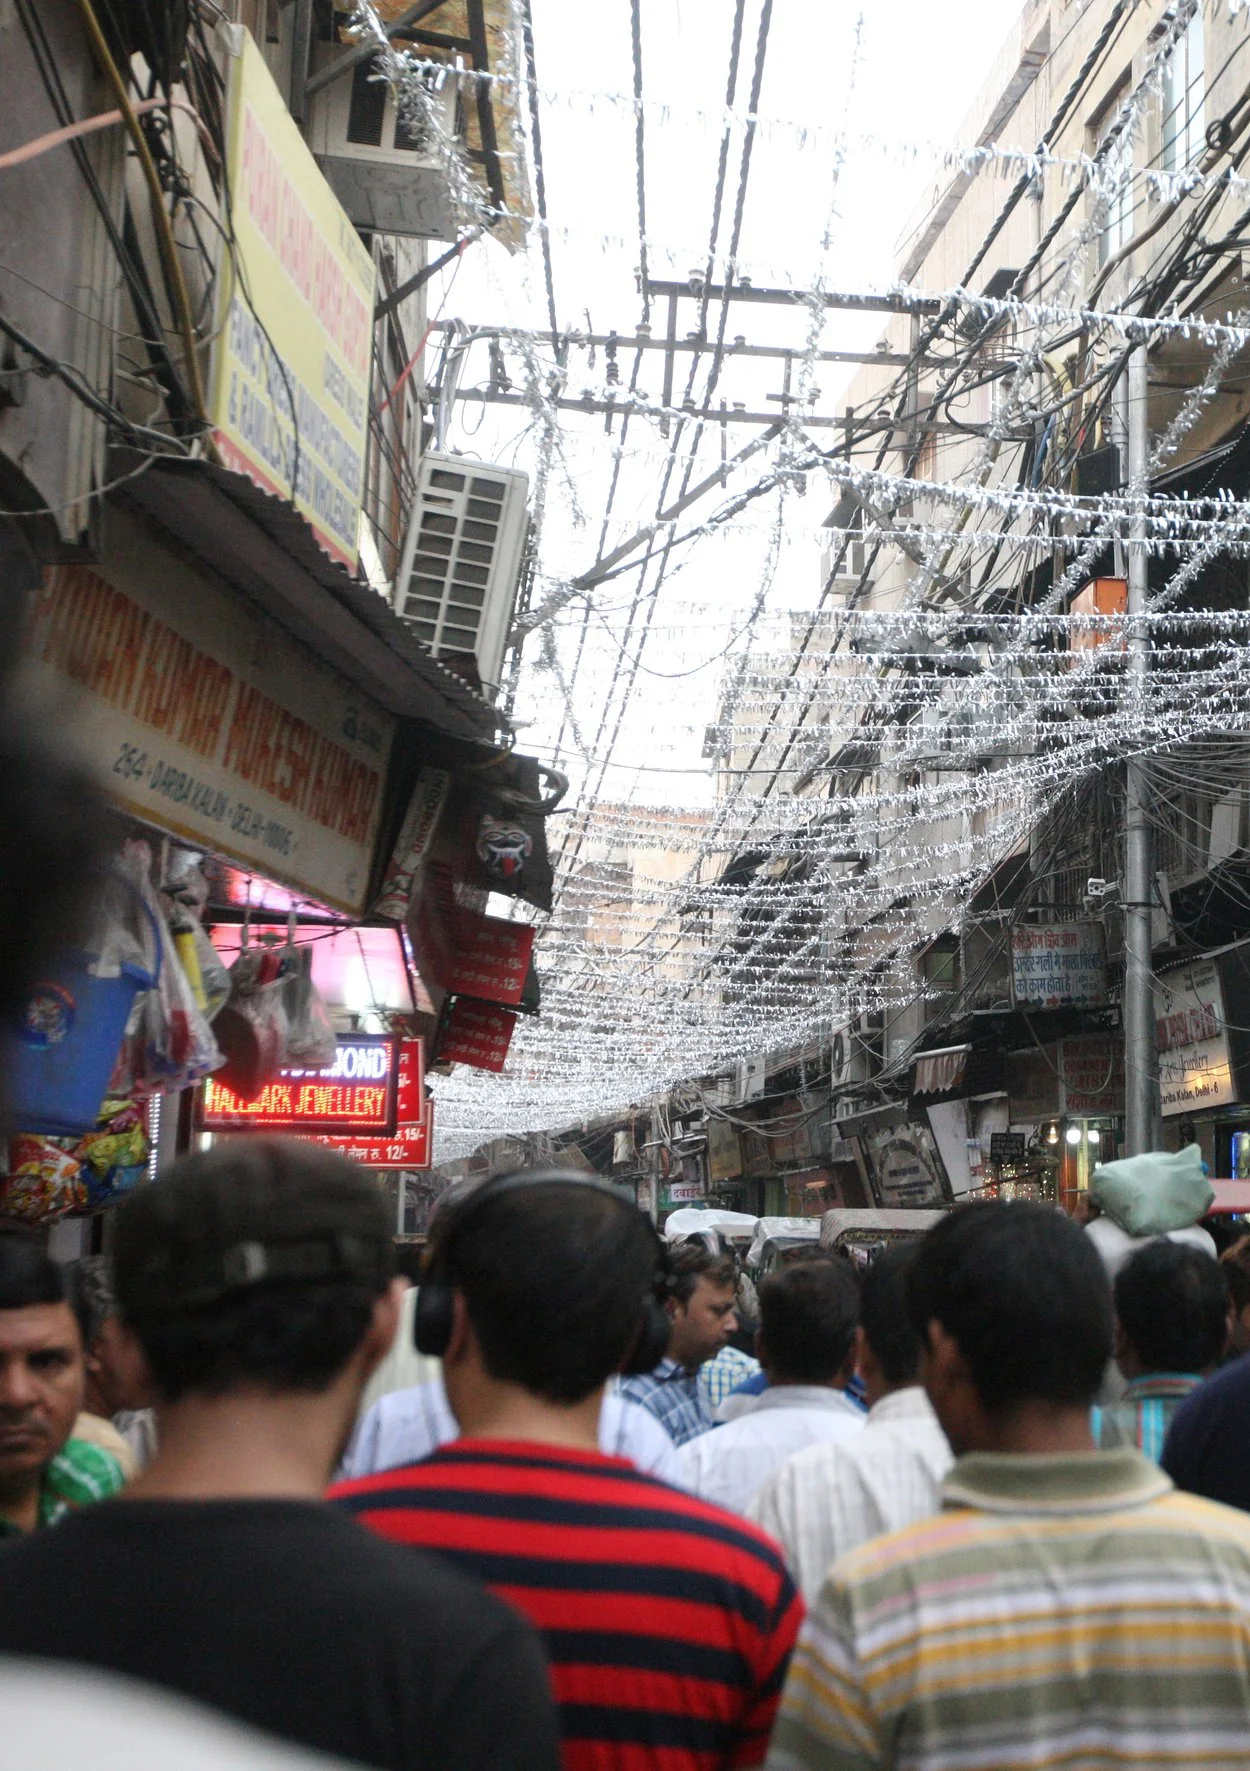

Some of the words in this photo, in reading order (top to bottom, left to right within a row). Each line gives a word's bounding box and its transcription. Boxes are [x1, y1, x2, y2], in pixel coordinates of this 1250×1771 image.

[1028, 977, 1046, 994] काम
[1195, 1083, 1210, 1097] Delhi
[208, 1084, 291, 1113] HALLARK
[295, 1085, 385, 1116] JEWELLERY
[386, 1145, 409, 1160] 12/-
